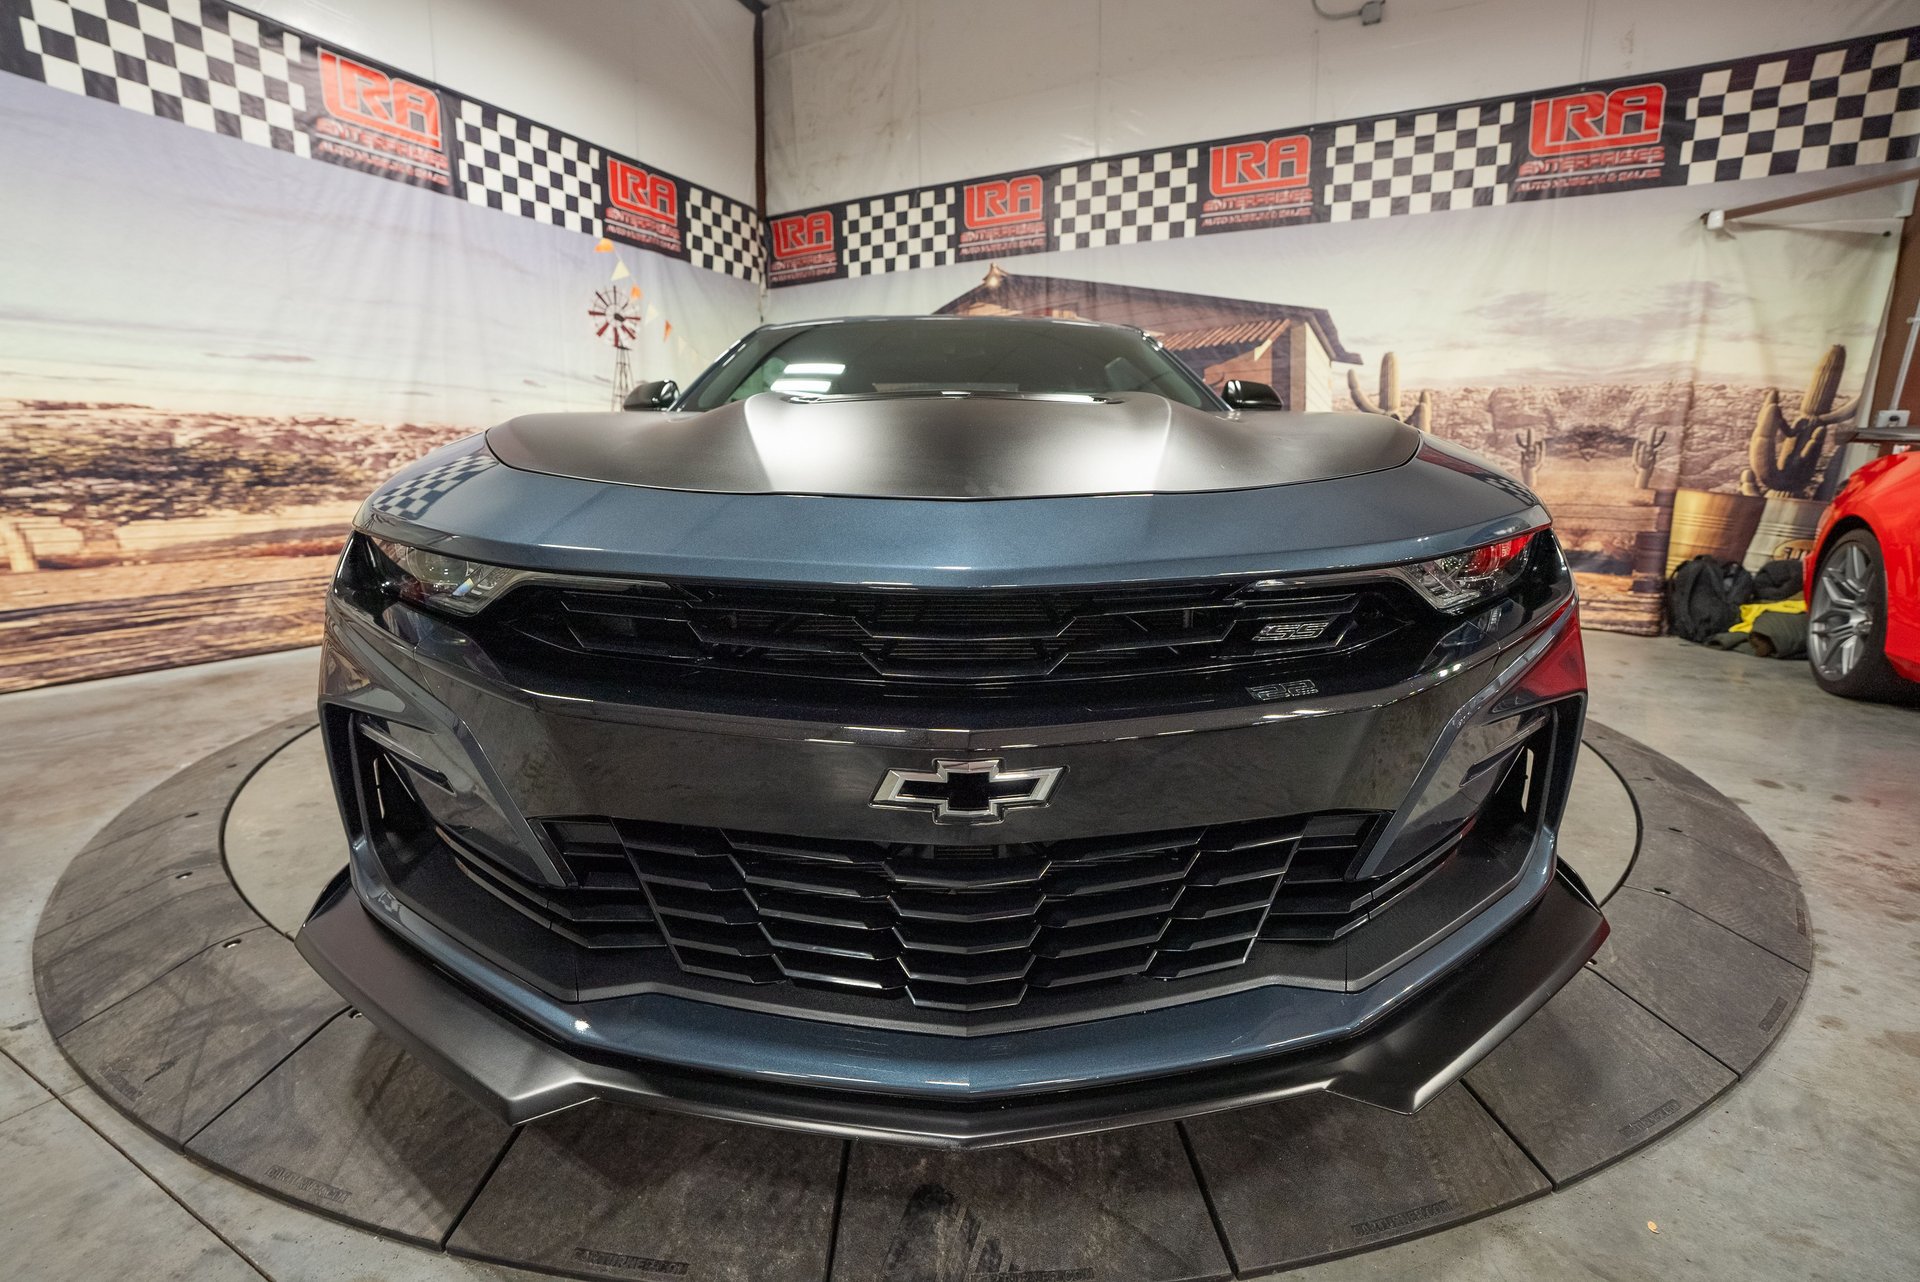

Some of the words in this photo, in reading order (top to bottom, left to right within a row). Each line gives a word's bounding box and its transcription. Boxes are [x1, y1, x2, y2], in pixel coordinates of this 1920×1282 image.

[317, 47, 442, 151] LRA
[1529, 82, 1667, 157] LRA
[607, 155, 678, 227] LRA
[1209, 134, 1311, 197] LRA
[964, 175, 1043, 230] LRA
[770, 210, 834, 259] LRA
[1252, 622, 1330, 641] SS
